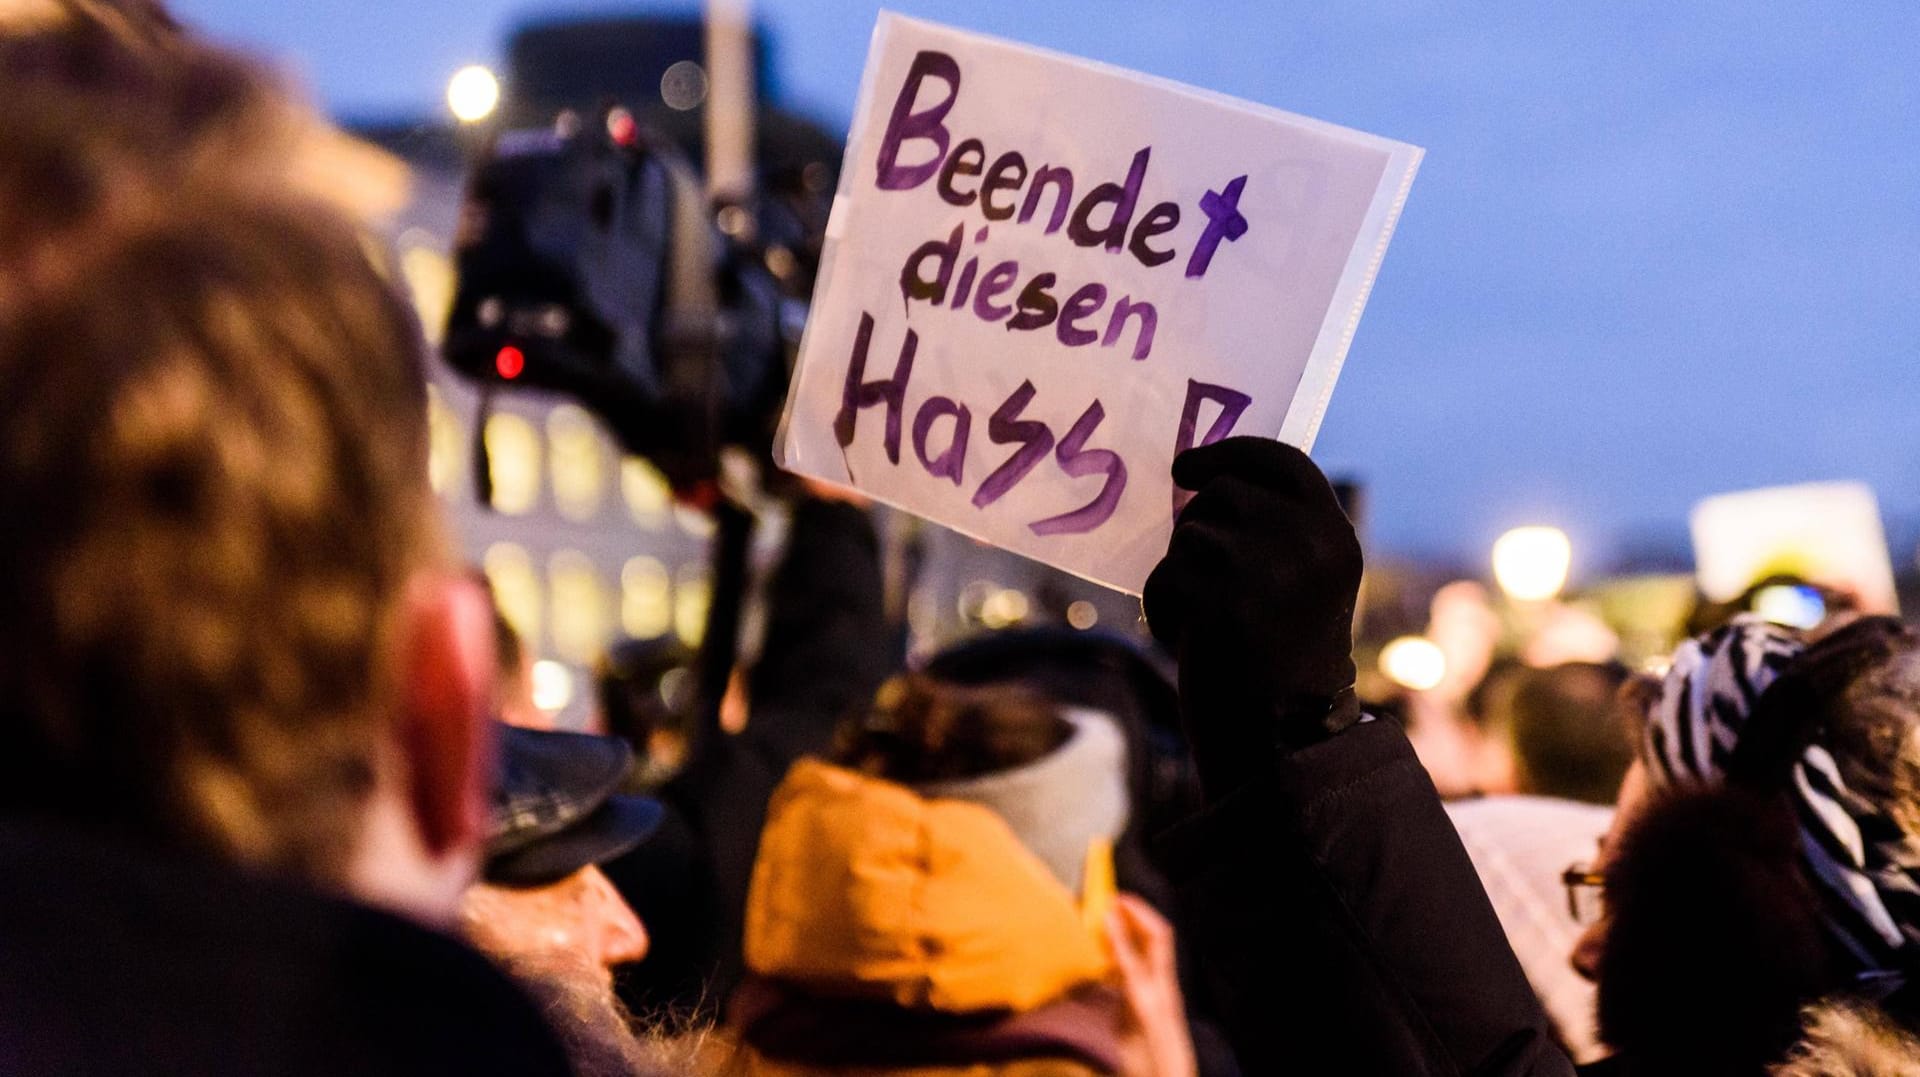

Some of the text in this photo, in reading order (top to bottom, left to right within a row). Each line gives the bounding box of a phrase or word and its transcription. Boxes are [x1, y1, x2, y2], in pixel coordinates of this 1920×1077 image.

[875, 50, 1248, 278] Beendet
[899, 222, 1158, 361] diesen
[833, 311, 1128, 536] Hass
